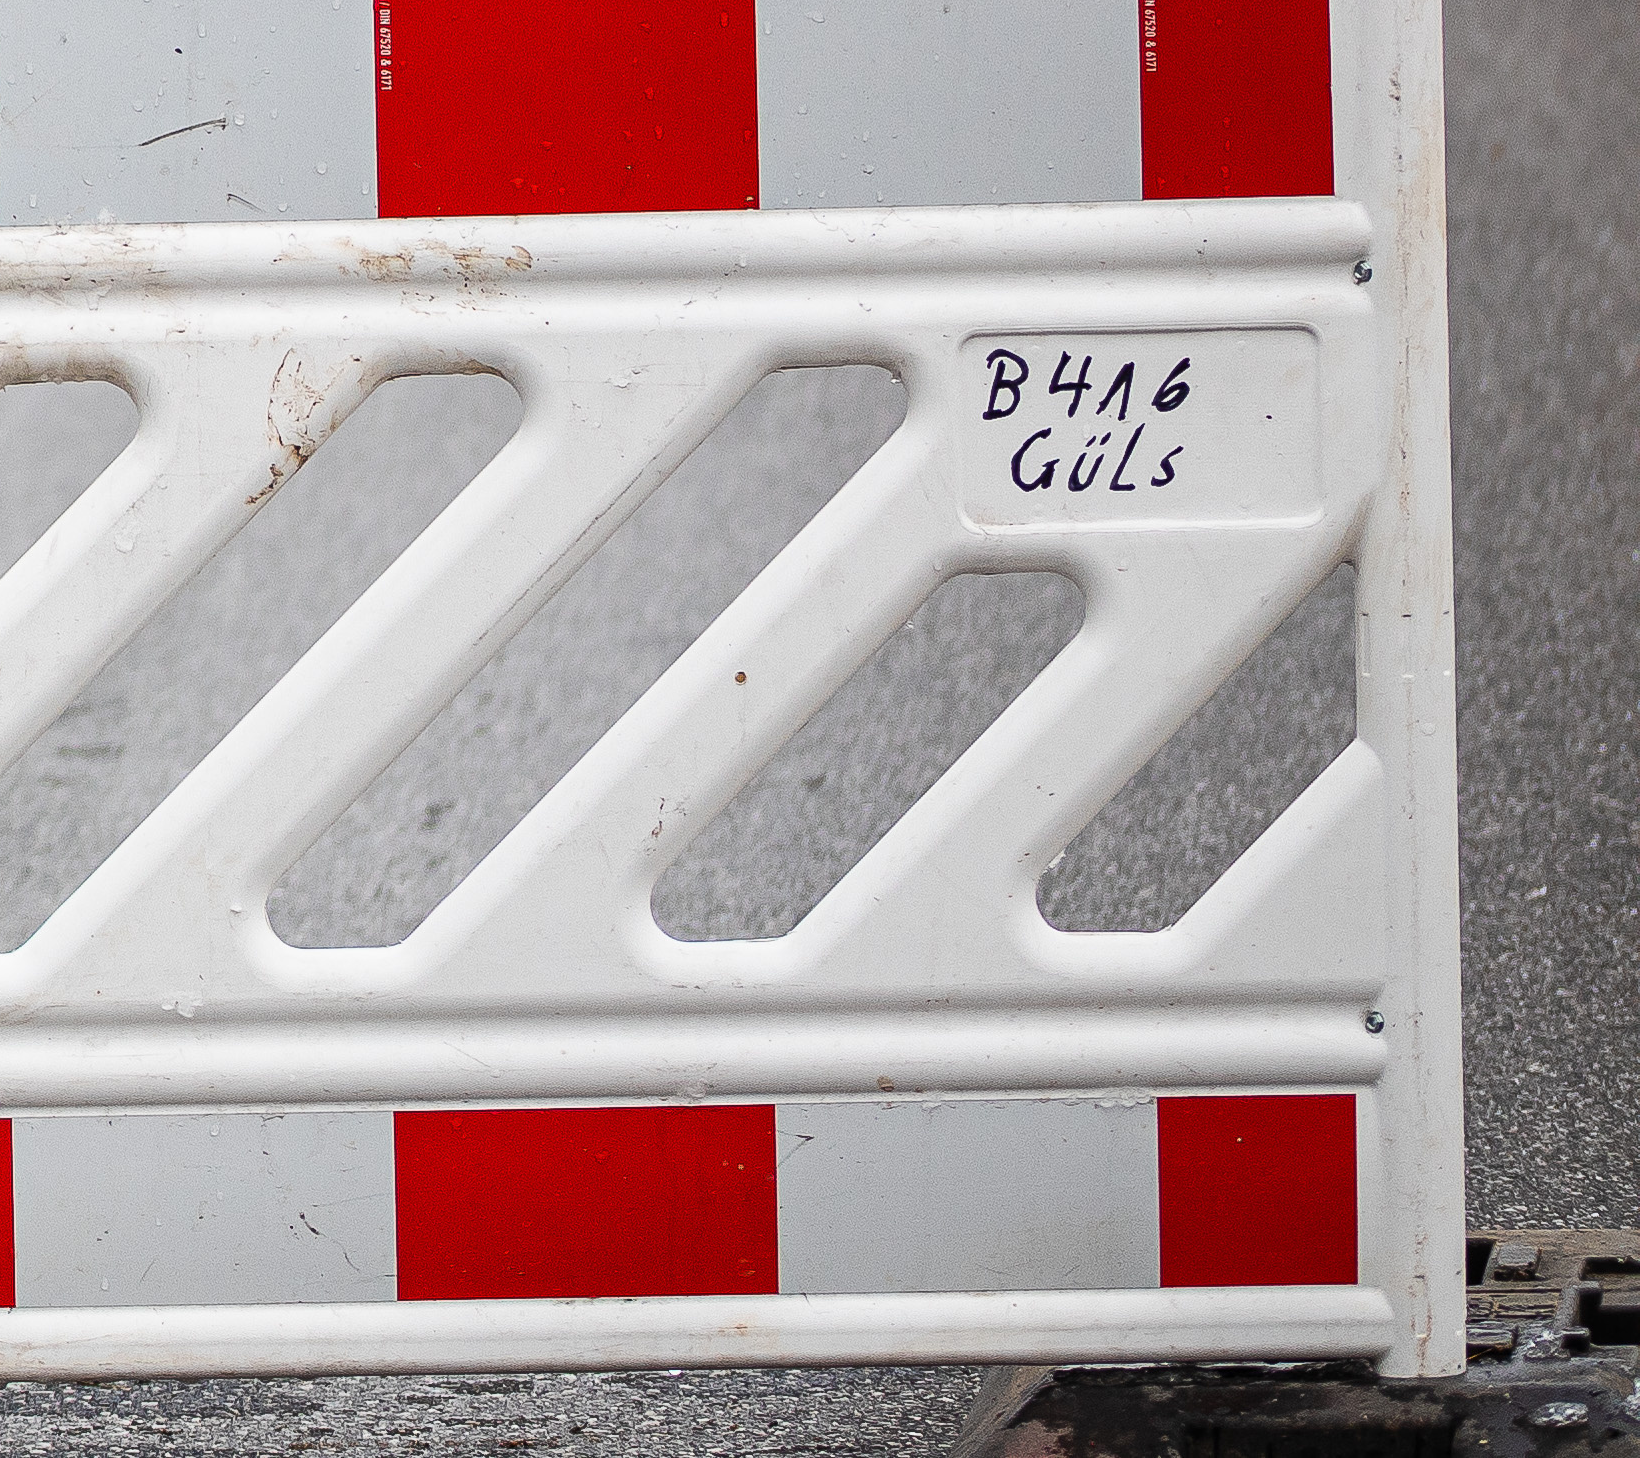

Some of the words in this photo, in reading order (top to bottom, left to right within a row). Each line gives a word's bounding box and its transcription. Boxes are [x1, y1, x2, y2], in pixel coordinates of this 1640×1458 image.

[379, 8, 391, 25] DIN
[1144, 9, 1157, 38] 67520
[379, 27, 392, 56] 67520
[1145, 40, 1157, 48] &
[380, 58, 392, 67] &
[1145, 51, 1157, 72] 6171
[380, 69, 393, 91] 6171
